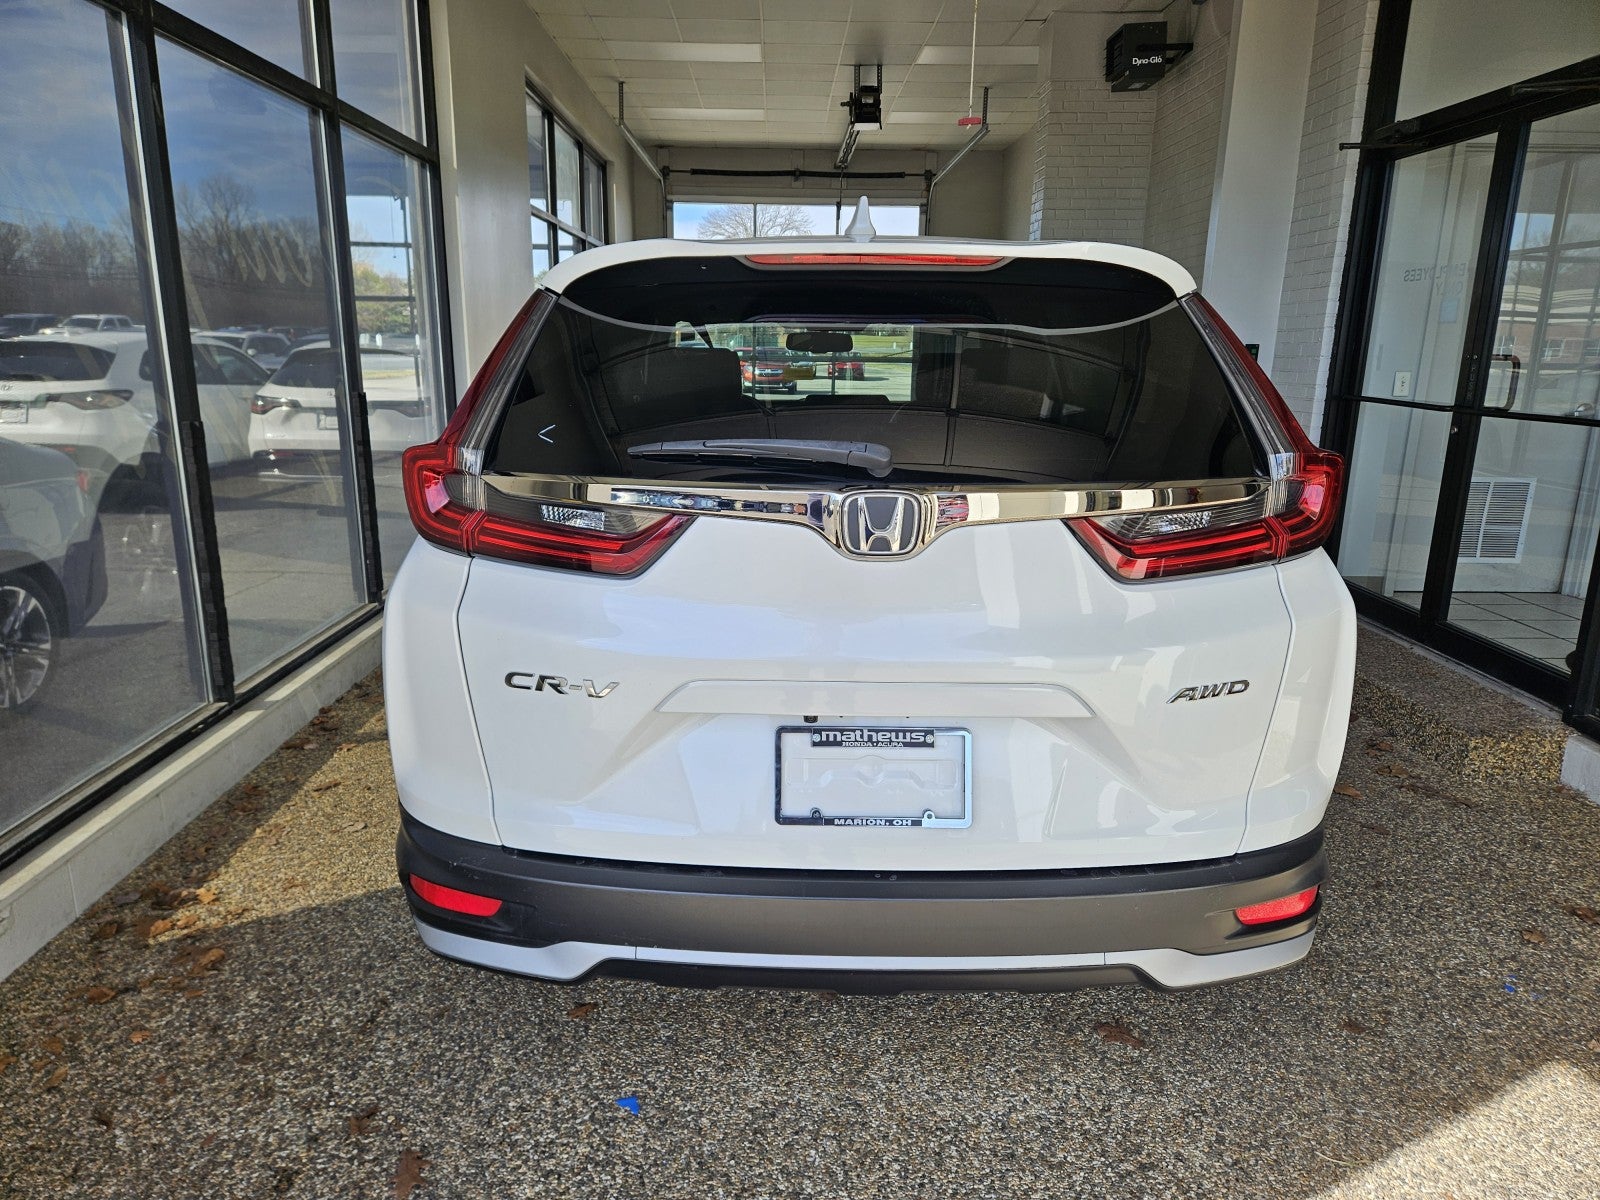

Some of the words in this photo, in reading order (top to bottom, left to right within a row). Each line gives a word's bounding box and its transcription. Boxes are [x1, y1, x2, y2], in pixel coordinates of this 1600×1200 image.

[504, 671, 620, 699] CR-V
[1166, 679, 1250, 704] AWD
[821, 728, 925, 742] mathews
[892, 819, 912, 827] OH
